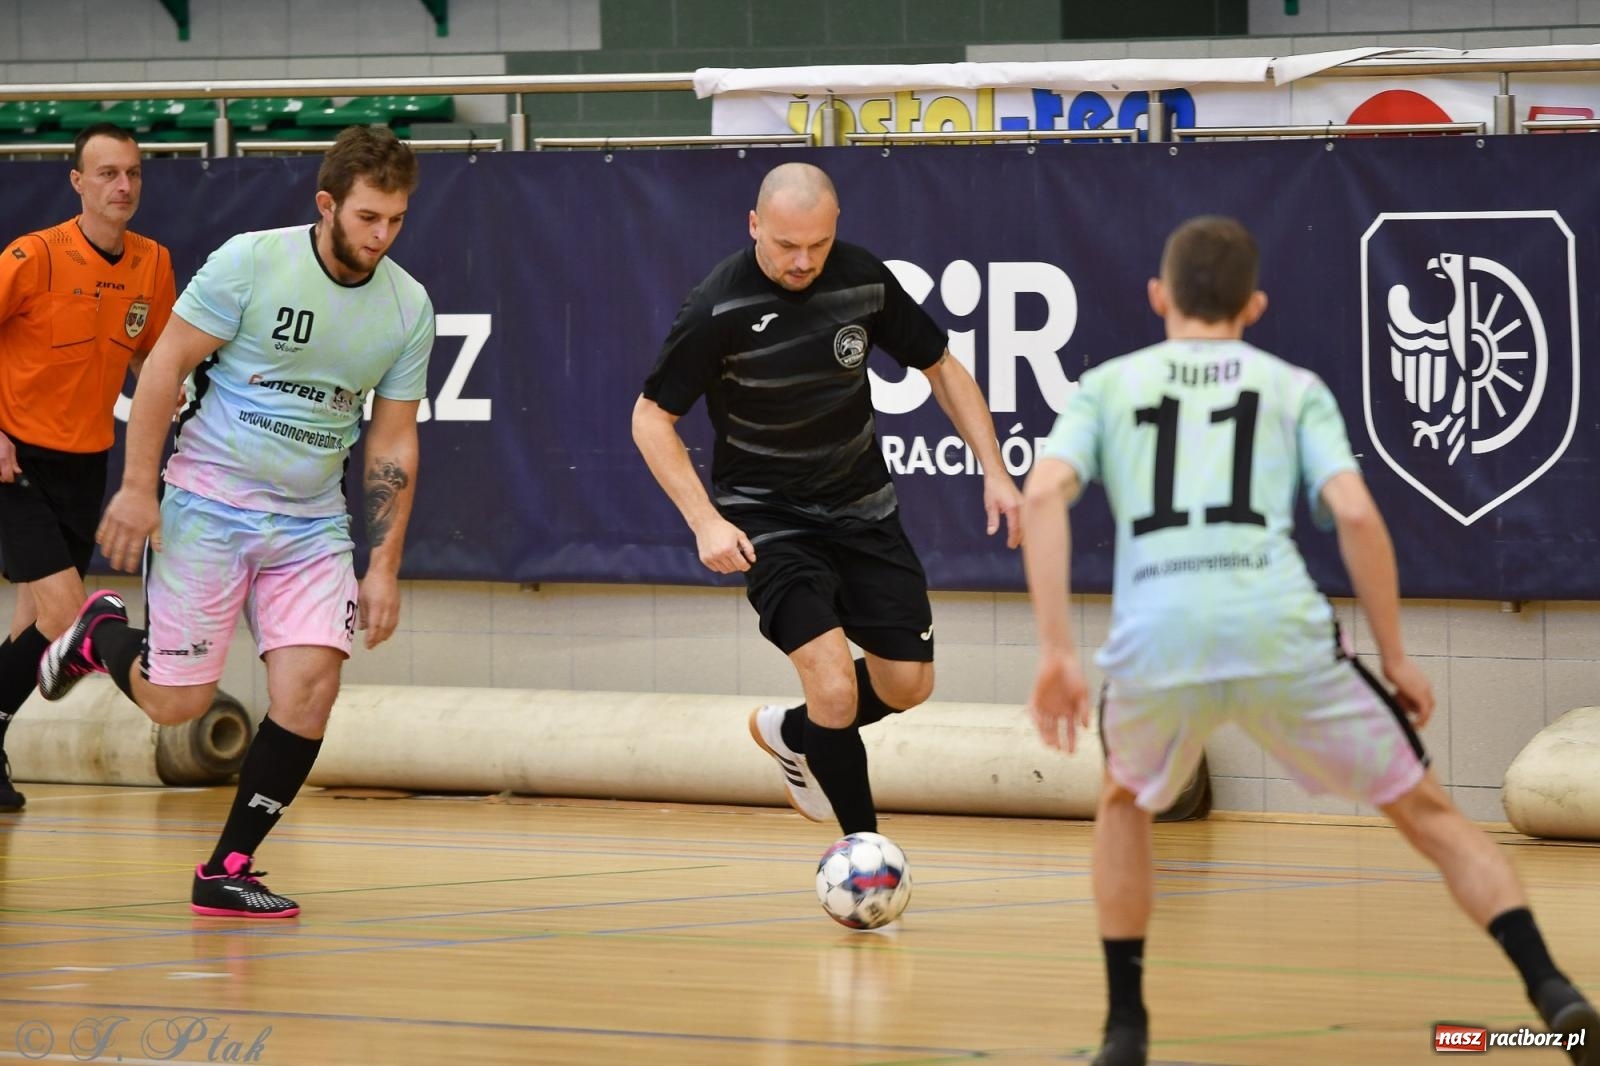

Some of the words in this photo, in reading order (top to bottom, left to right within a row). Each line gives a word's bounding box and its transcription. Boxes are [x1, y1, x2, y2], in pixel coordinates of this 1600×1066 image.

[271, 306, 315, 344] 20
[881, 422, 1052, 477] RACIÓ
[1132, 389, 1267, 538] 11
